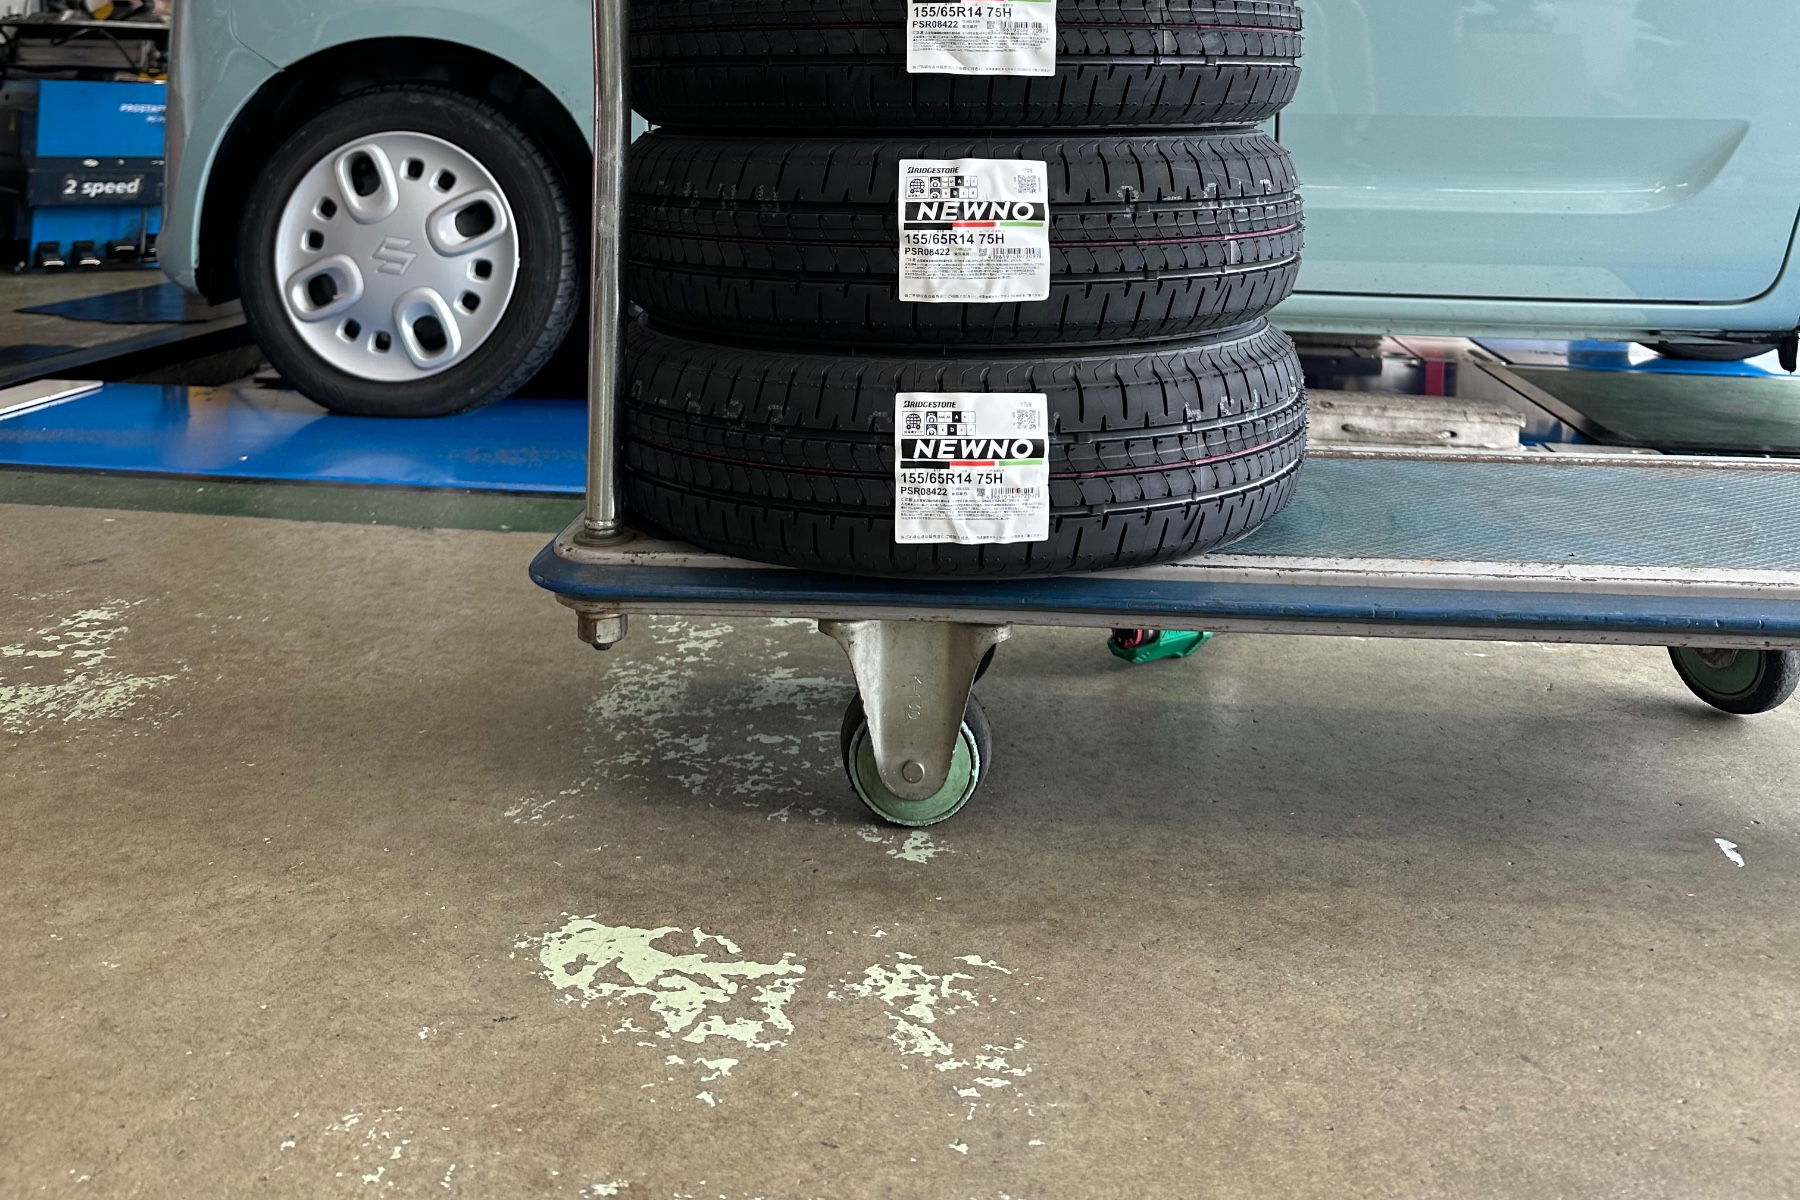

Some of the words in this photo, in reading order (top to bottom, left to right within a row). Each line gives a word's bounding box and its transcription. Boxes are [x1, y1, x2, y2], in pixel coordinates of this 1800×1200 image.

[913, 6, 982, 18] 155/65R14
[986, 6, 1012, 18] 75H
[912, 20, 959, 29] PSR08422
[907, 166, 960, 174] BRIDGESTONE
[63, 179, 78, 195] 2
[80, 177, 141, 198] speed
[916, 201, 1035, 221] NEWNO
[904, 233, 975, 245] 155/65R14
[979, 233, 1005, 245] 75H
[904, 247, 950, 256] PSR08422
[903, 400, 957, 408] BRIDGESTONE
[912, 439, 1034, 459] NEWNO
[900, 472, 972, 485] 155/65R14
[976, 472, 1003, 485] 75H
[900, 486, 948, 496] PSR08422
